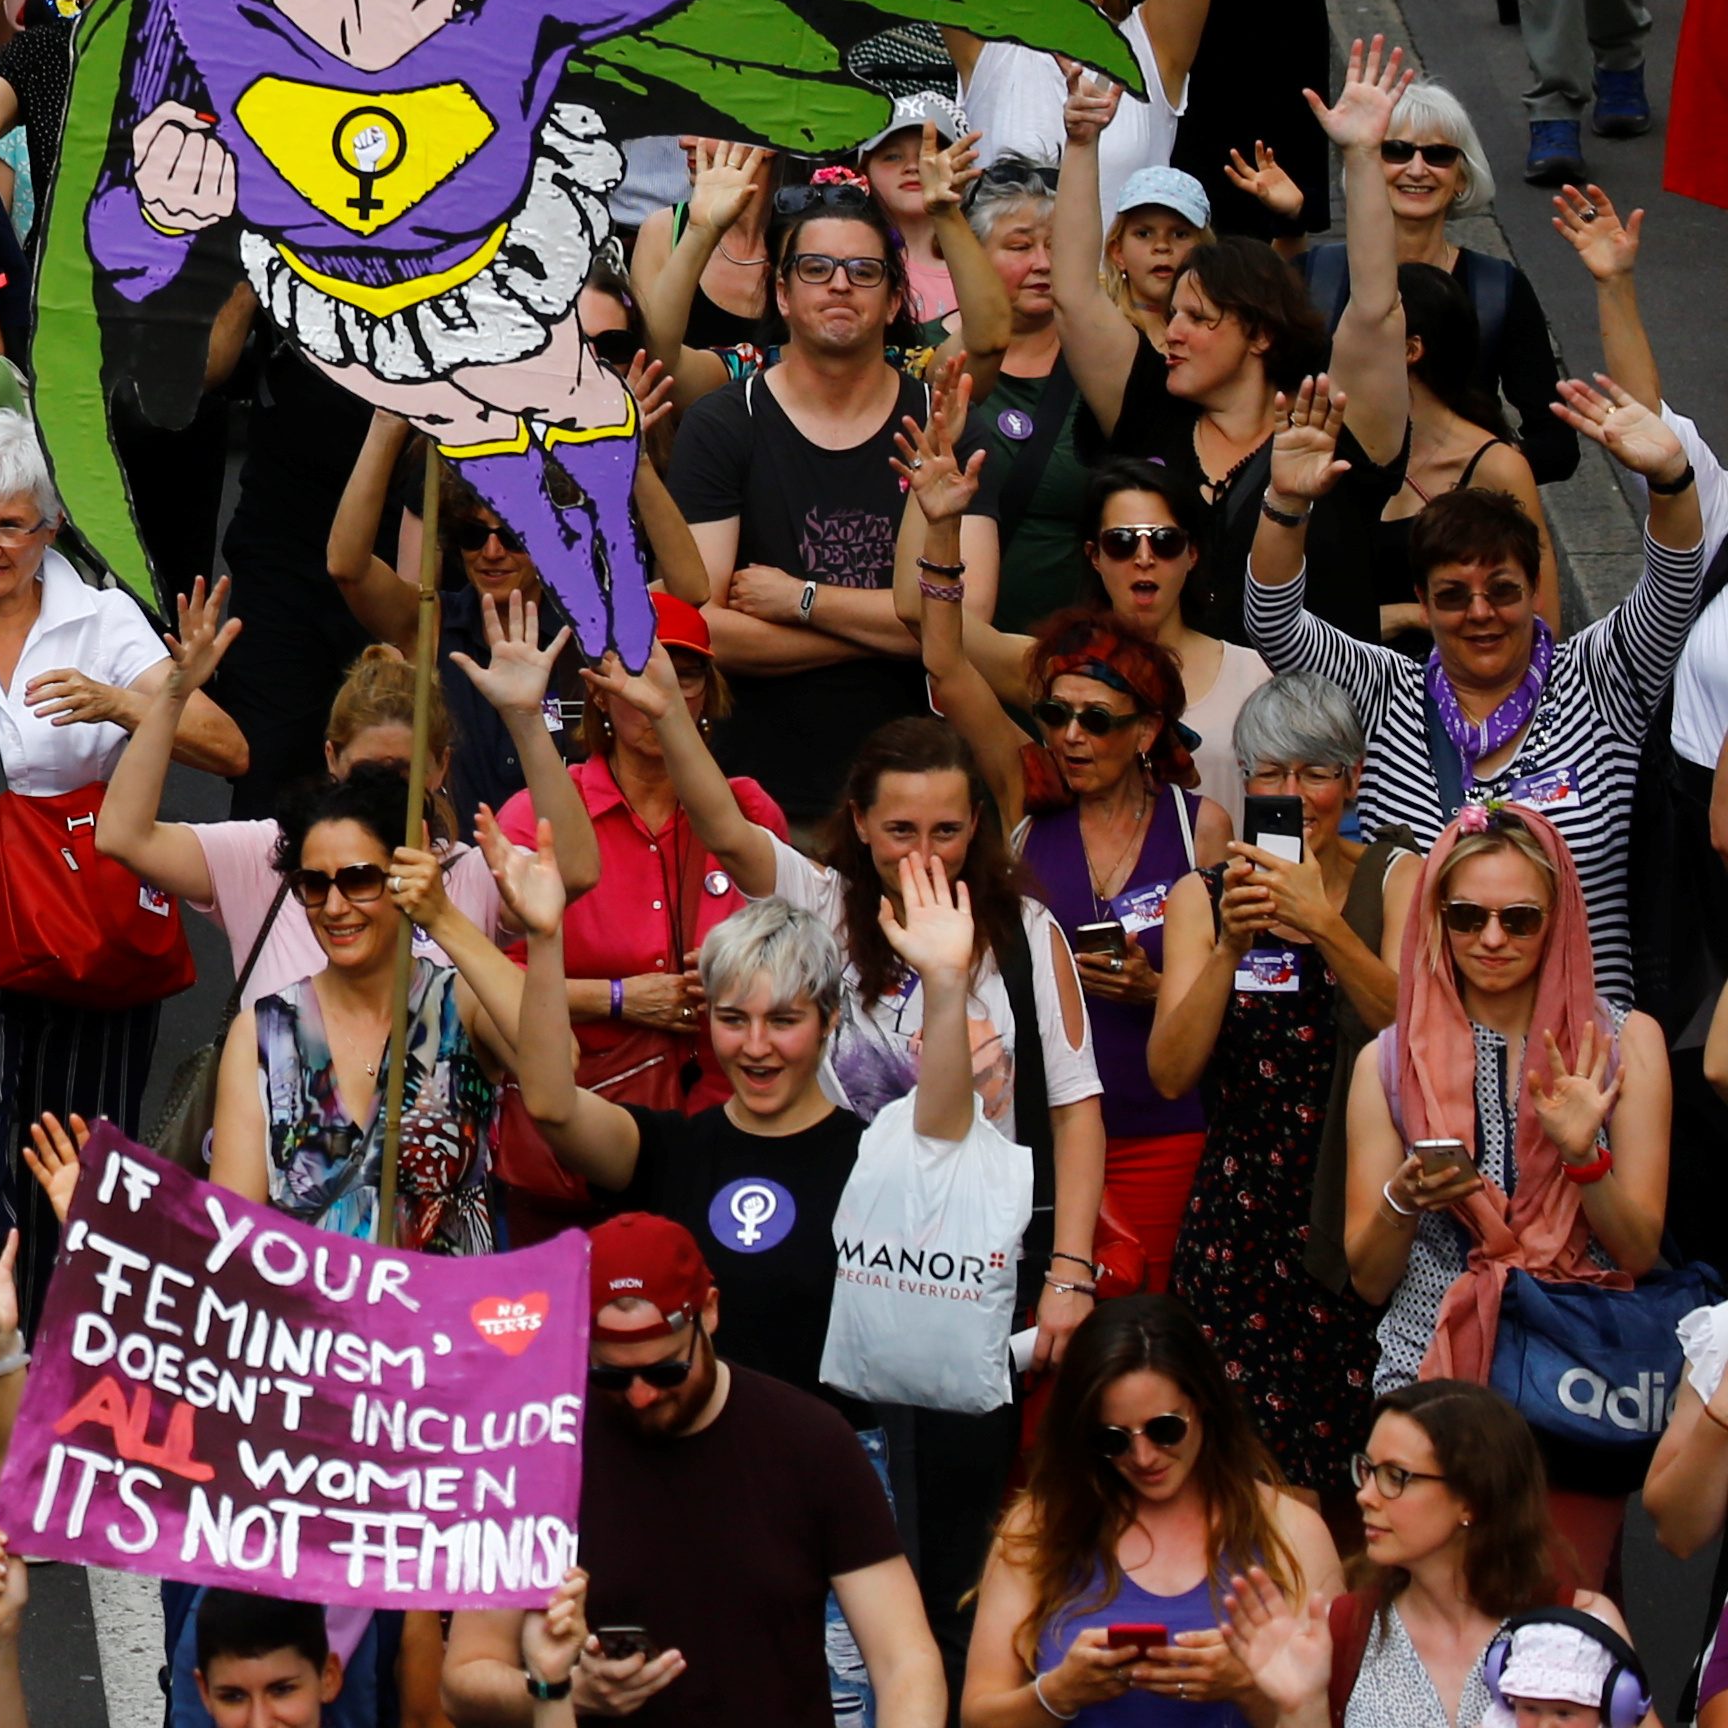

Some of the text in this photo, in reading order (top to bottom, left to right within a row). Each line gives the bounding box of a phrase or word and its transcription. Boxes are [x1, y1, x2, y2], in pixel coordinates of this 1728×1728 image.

[95, 1150, 161, 1214] IF
[204, 1194, 422, 1314] YOUR
[608, 1276, 644, 1291] NIXON
[836, 1236, 985, 1285] MANOR
[836, 1266, 984, 1303] PECIAL EVERYDAY
[496, 1301, 527, 1318] NO
[70, 1312, 583, 1455] DOESN'T INCLUDE
[1556, 1366, 1680, 1434] adi
[52, 1374, 518, 1512] ALL WOMEN
[31, 1440, 165, 1556] IT'S
[178, 1484, 321, 1581] NOT
